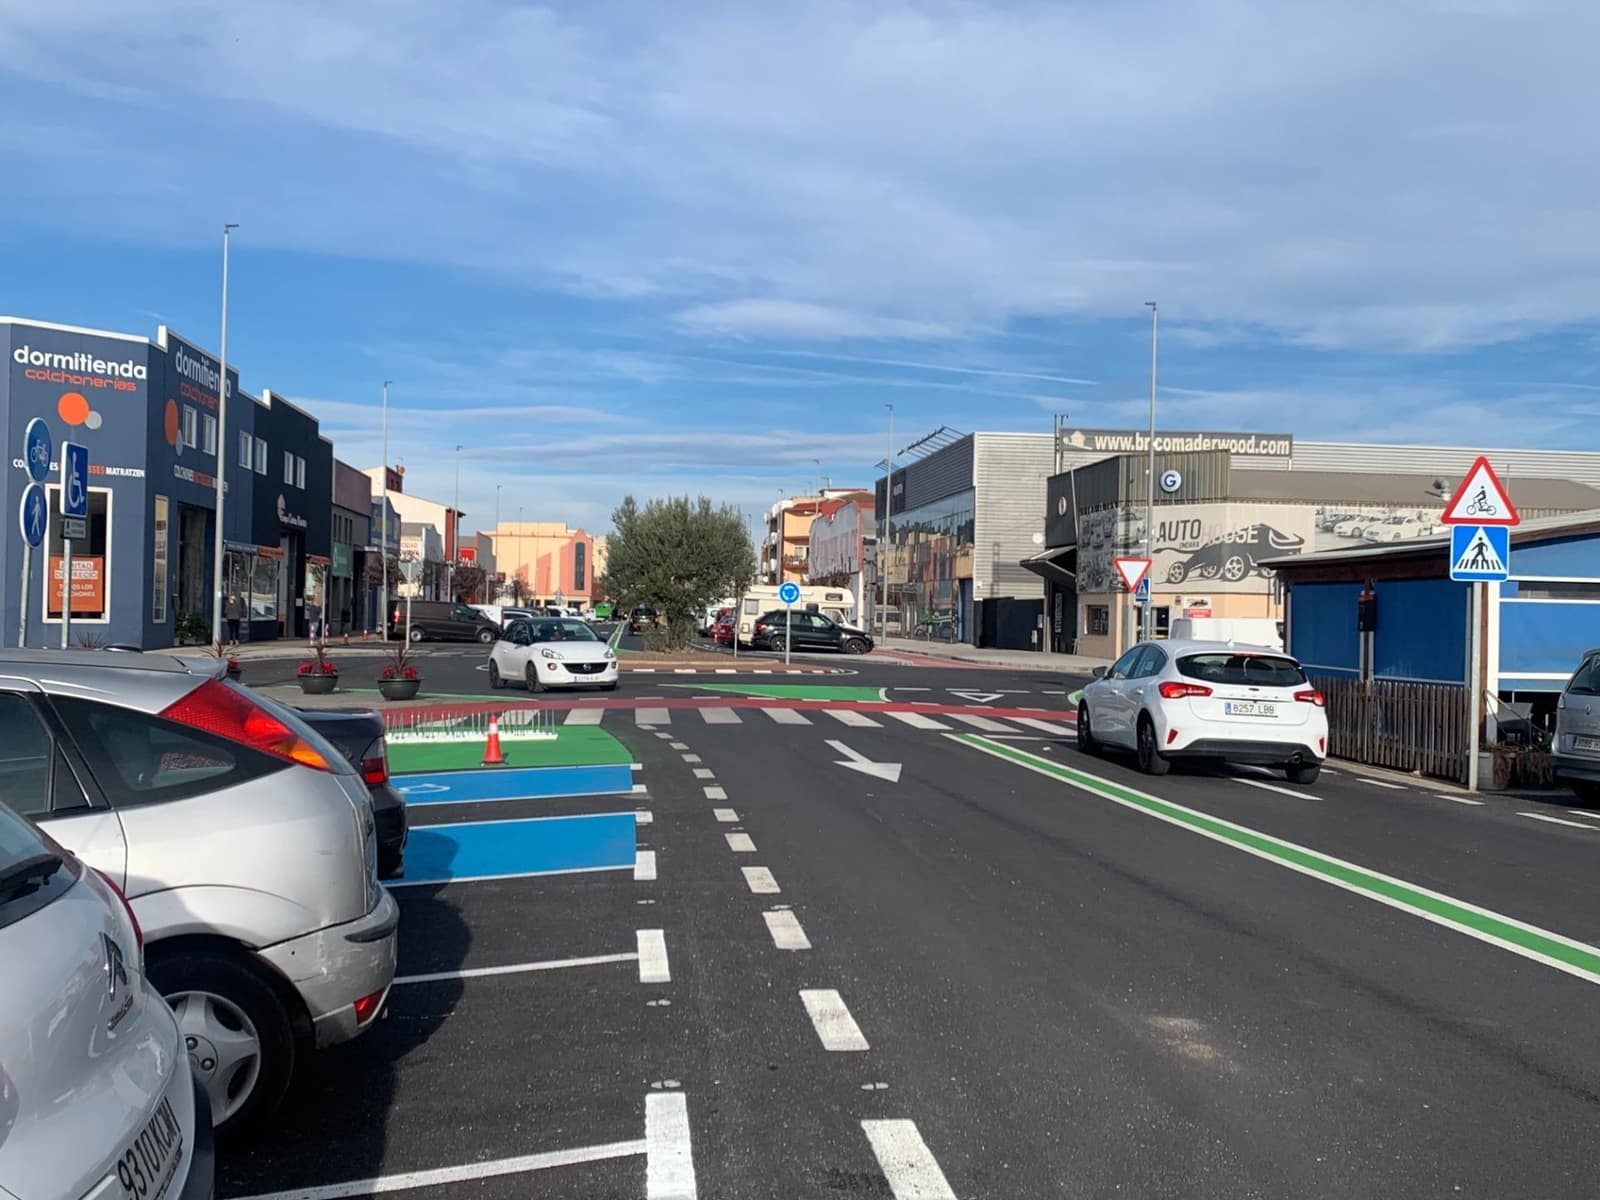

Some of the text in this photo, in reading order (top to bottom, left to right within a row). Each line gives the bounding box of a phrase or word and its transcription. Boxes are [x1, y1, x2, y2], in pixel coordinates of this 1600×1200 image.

[13, 345, 147, 380] dormitienda
[175, 346, 231, 399] dormitiena
[1095, 432, 1290, 455] www.brcomaderwood.com
